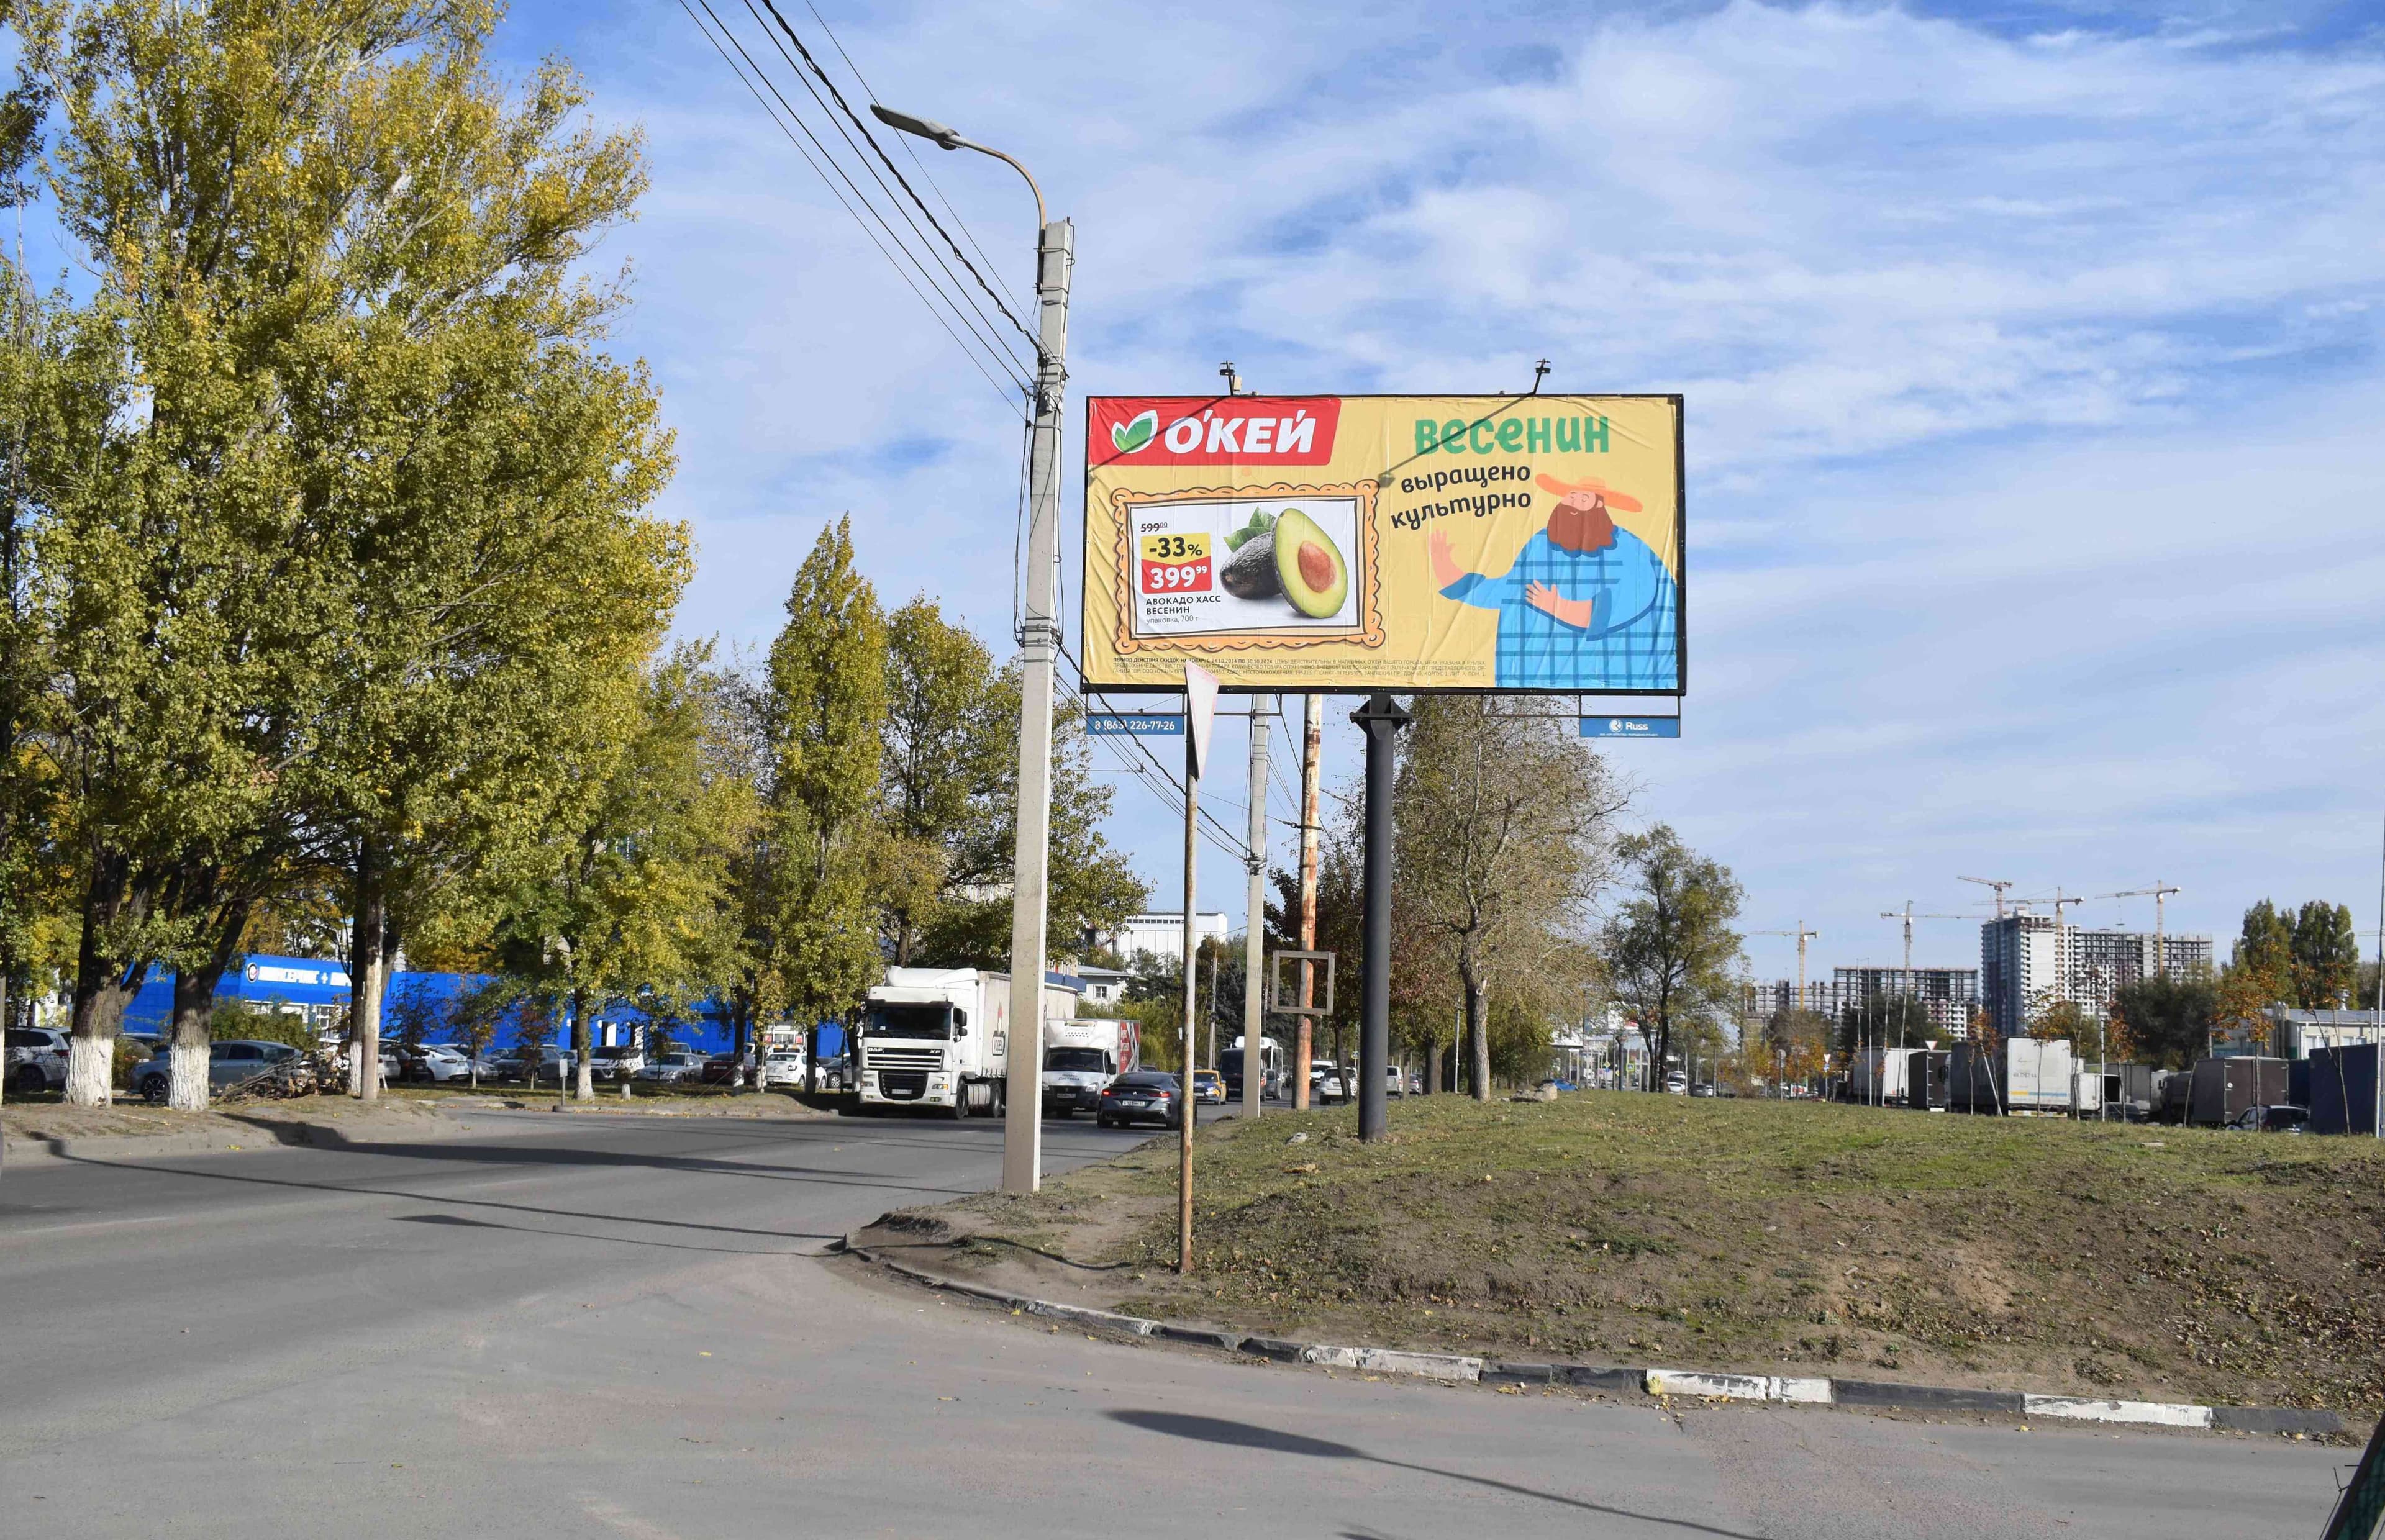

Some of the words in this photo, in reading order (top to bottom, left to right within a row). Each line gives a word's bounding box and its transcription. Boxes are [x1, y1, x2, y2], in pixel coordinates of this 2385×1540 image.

[1414, 416, 1610, 455] весенин
[1401, 464, 1531, 493] выращено
[1391, 493, 1532, 530] культурно
[1149, 537, 1203, 558] -33%
[1146, 597, 1194, 605] АВОКАДО
[1196, 595, 1221, 604] ХАСС
[1147, 606, 1190, 615] ВЕСЕНИН
[1147, 617, 1179, 625] упаковка,
[1095, 720, 1101, 730] 8
[1130, 720, 1175, 730] 226-77-26
[1625, 722, 1648, 730] Russ
